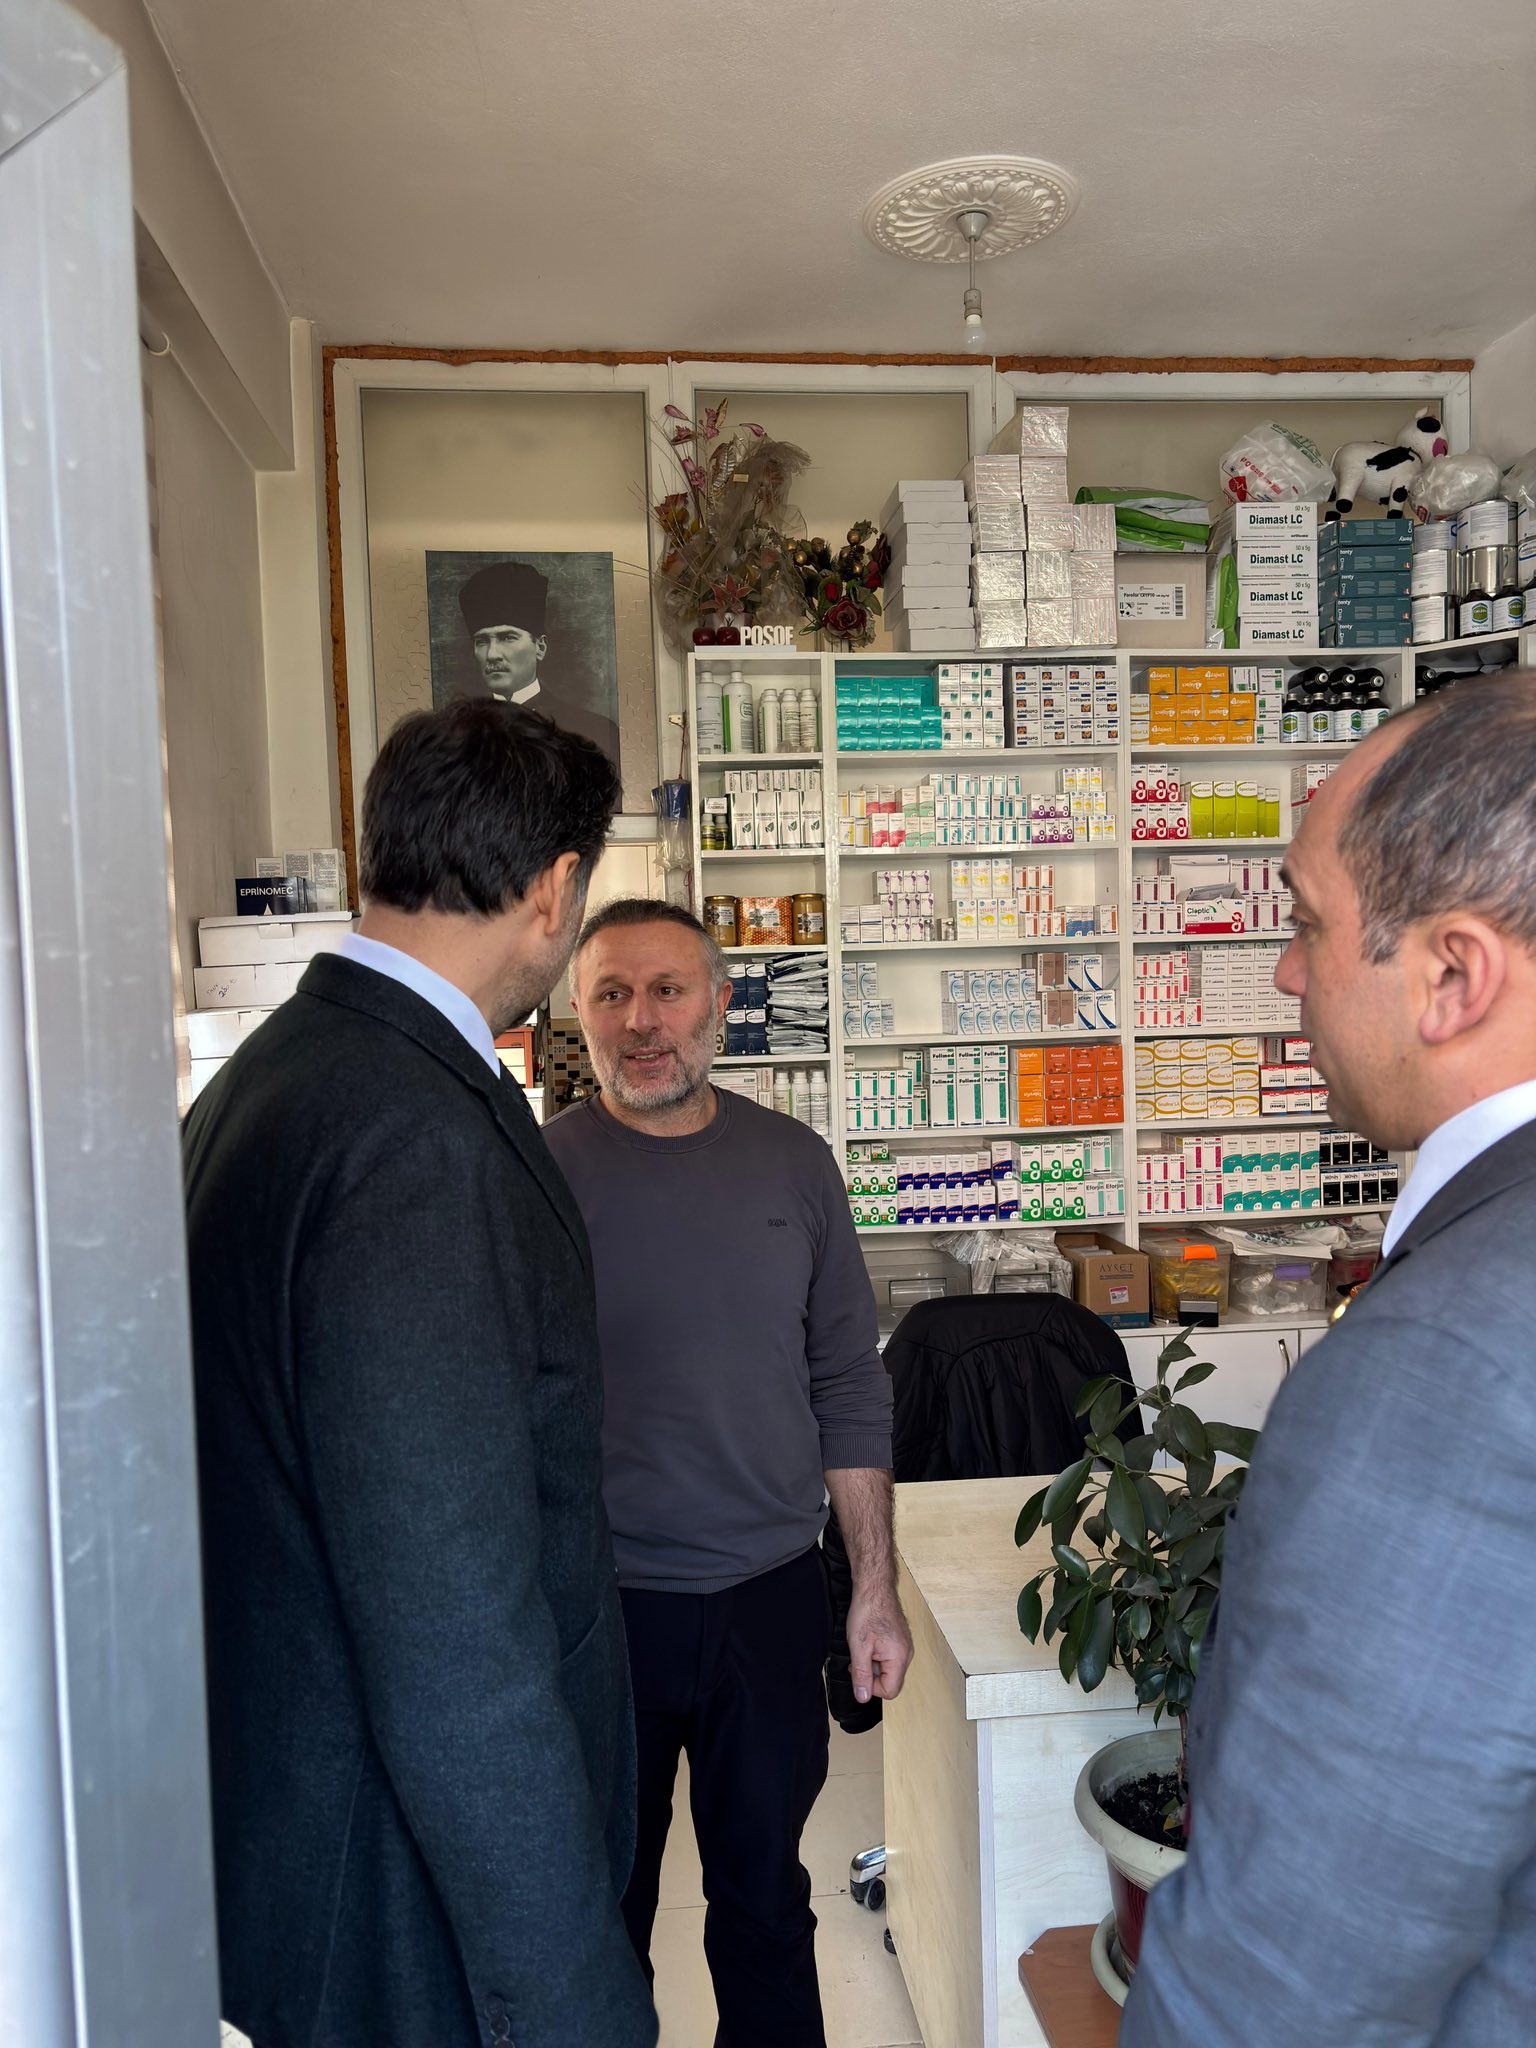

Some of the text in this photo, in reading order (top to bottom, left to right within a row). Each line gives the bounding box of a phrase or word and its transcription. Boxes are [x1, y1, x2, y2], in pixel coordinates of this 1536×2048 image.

[1249, 514, 1303, 524] Diamast LC
[1250, 554, 1303, 564] Diamast LC
[1250, 591, 1303, 601] Diamast LC
[740, 625, 794, 645] POSOF
[1252, 629, 1304, 639] Diamast LC
[240, 886, 294, 897] EPRİNOMEC
